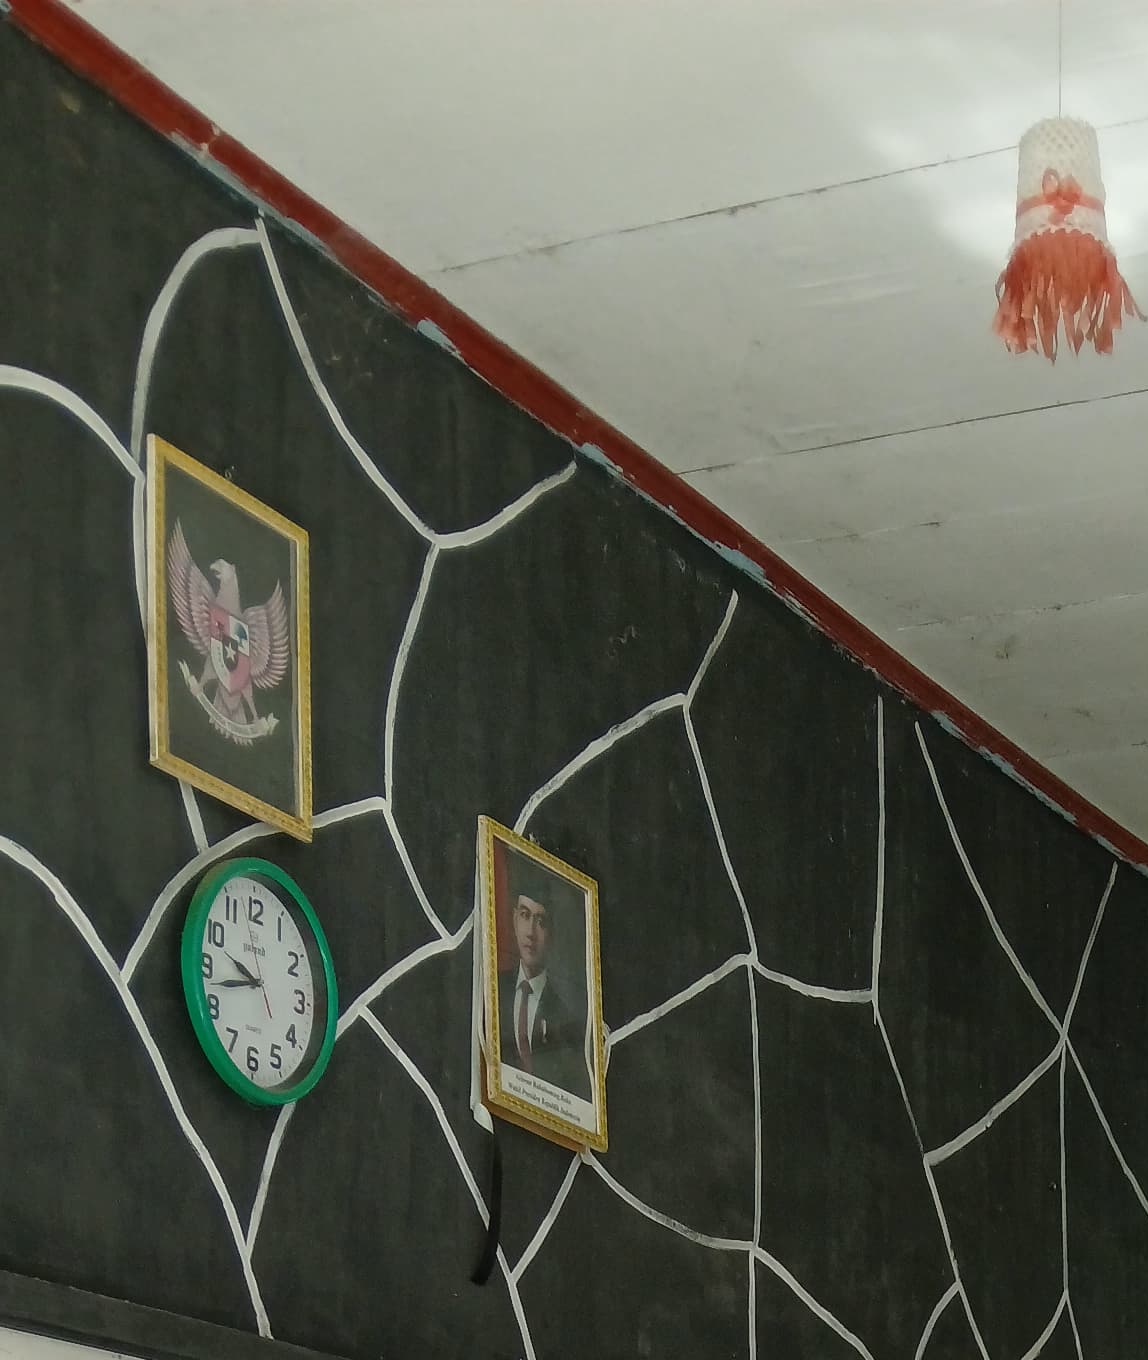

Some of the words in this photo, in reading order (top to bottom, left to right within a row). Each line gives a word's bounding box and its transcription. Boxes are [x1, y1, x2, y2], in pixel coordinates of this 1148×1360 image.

[226, 895, 238, 924] 11
[249, 895, 264, 926] 12
[208, 918, 225, 948] 10
[201, 952, 213, 979] 9
[287, 951, 299, 978] 2
[207, 993, 220, 1020] 8
[293, 989, 306, 1015] 3
[226, 1027, 239, 1053] 7
[285, 1023, 298, 1049] 4
[246, 1046, 259, 1072] 6
[269, 1043, 282, 1070] 5
